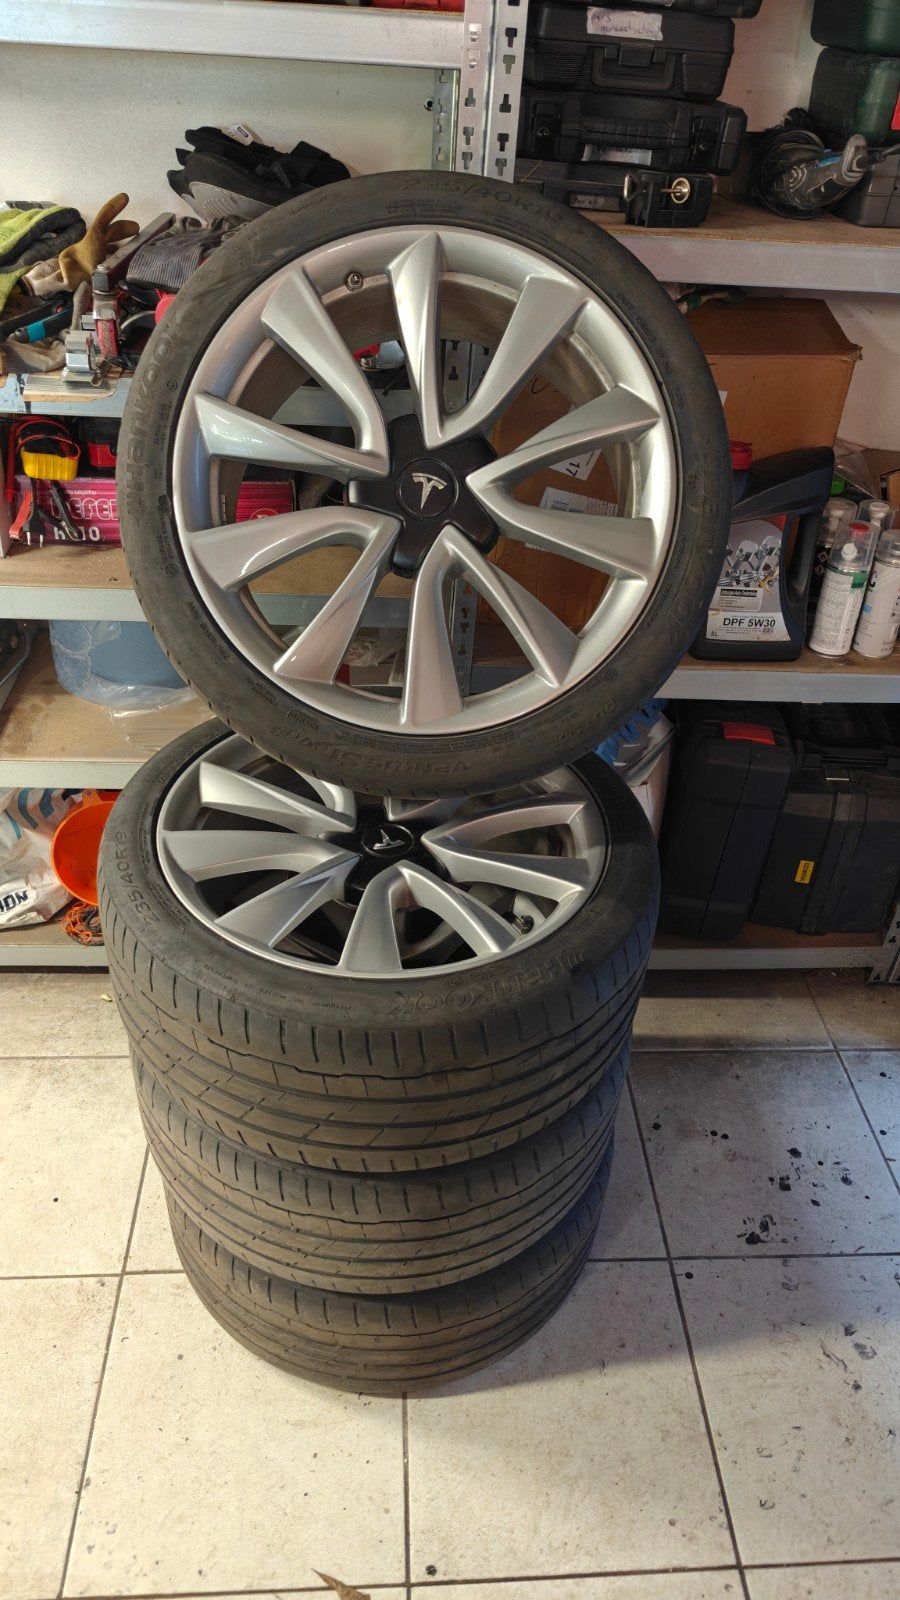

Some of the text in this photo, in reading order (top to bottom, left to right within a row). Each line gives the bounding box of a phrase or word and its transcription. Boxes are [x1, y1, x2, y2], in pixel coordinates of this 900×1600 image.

[122, 311, 192, 493] Hankook
[723, 617, 776, 628] DPF 5W30
[115, 830, 162, 925] 235/40R19
